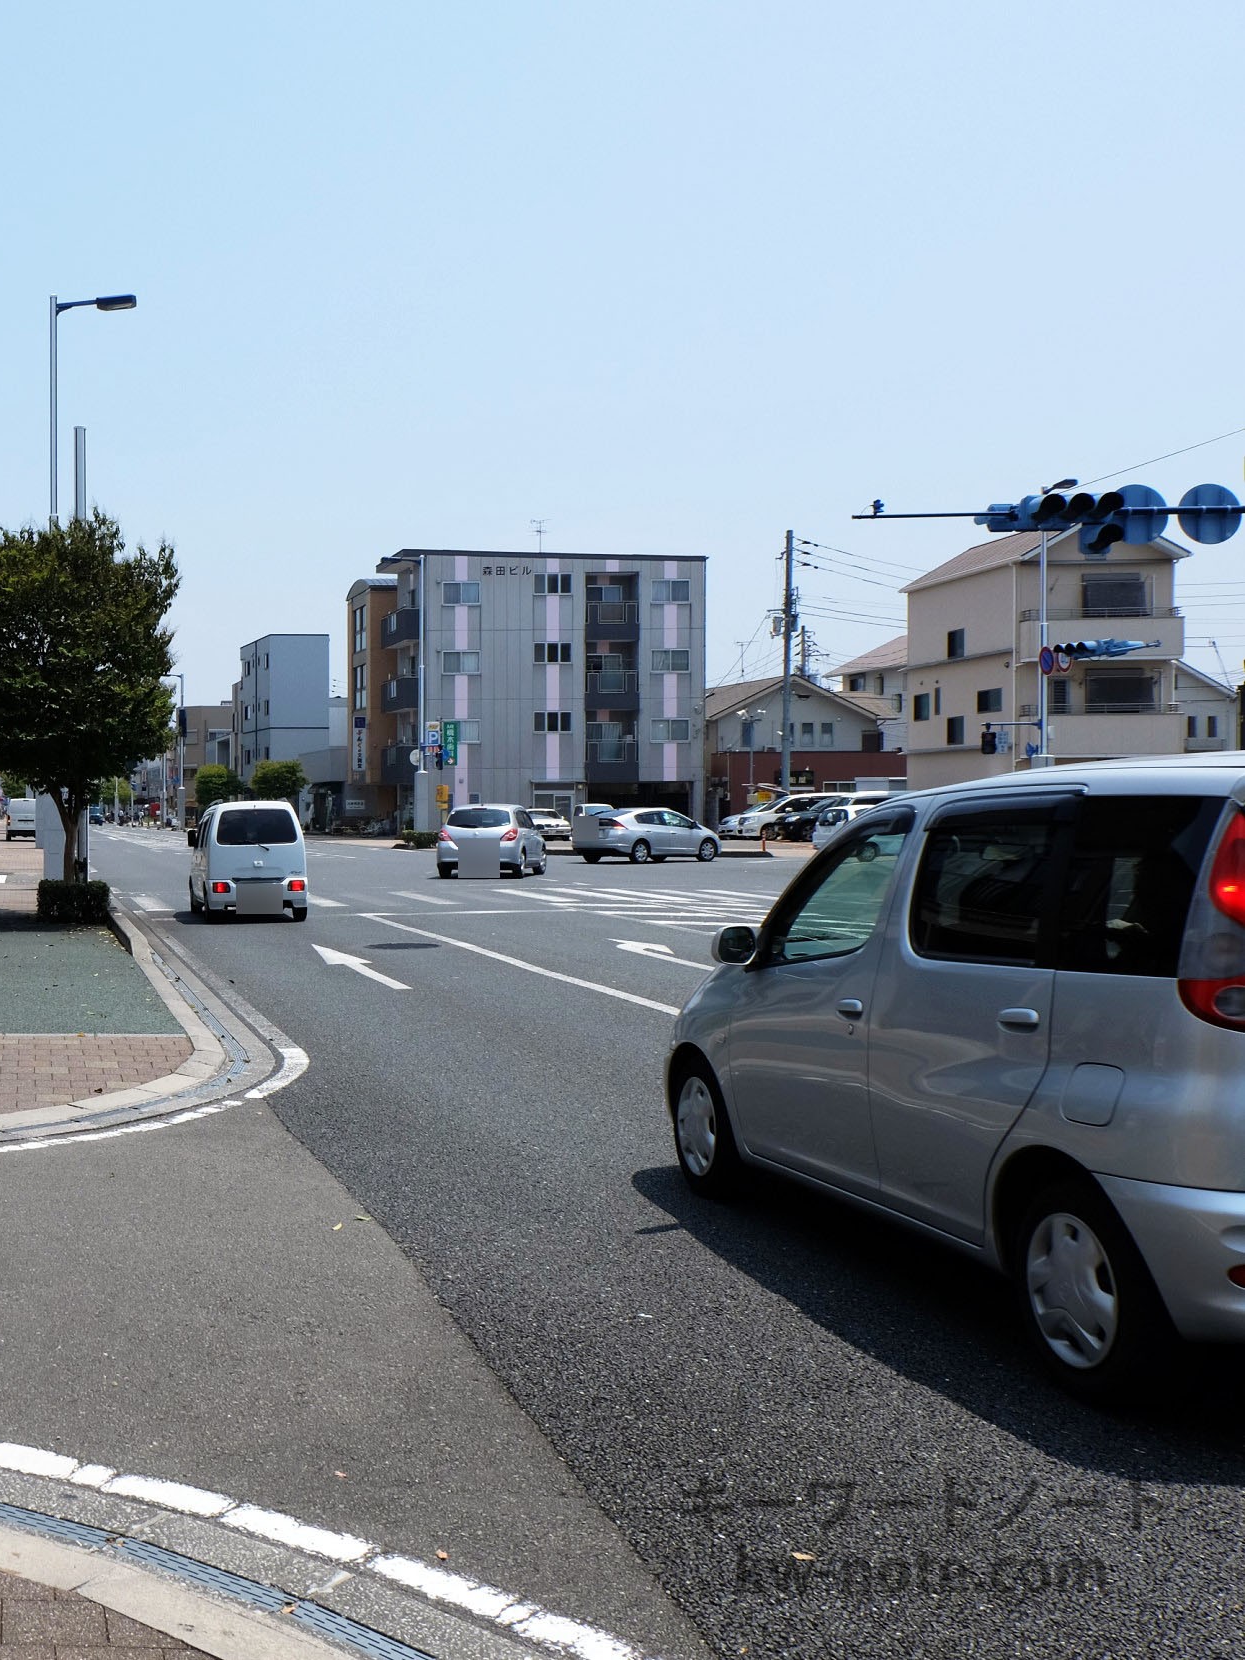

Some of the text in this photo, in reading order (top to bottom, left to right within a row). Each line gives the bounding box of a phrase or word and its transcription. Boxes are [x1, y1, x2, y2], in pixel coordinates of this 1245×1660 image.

[482, 566, 532, 576] 森田ビル
[428, 731, 438, 744] P
